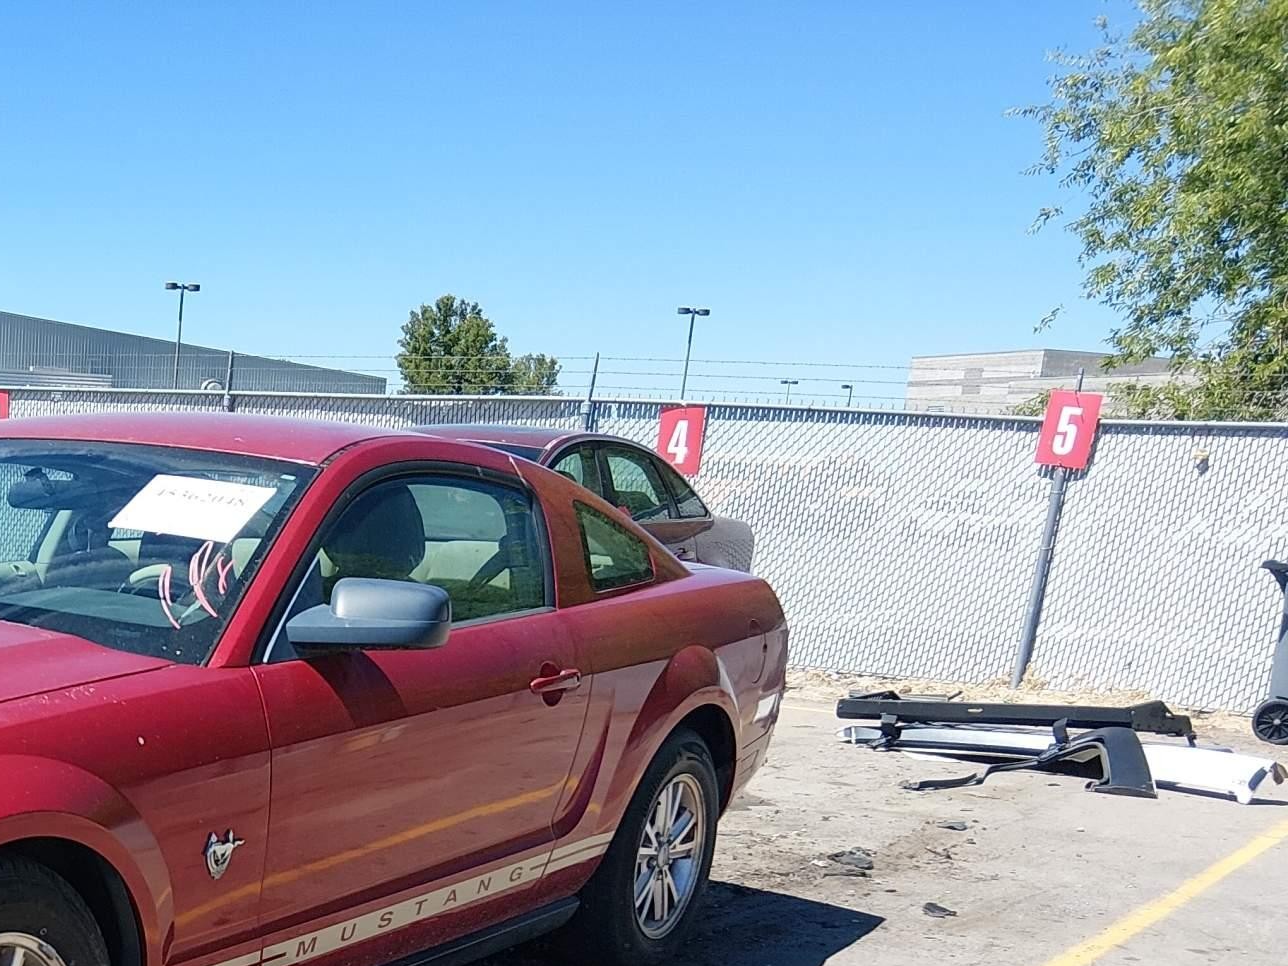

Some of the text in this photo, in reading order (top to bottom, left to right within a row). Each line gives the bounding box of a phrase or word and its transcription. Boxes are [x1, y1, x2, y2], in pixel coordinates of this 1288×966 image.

[667, 420, 689, 464] 4
[1052, 406, 1083, 456] 5
[295, 865, 524, 958] MUSTANG
